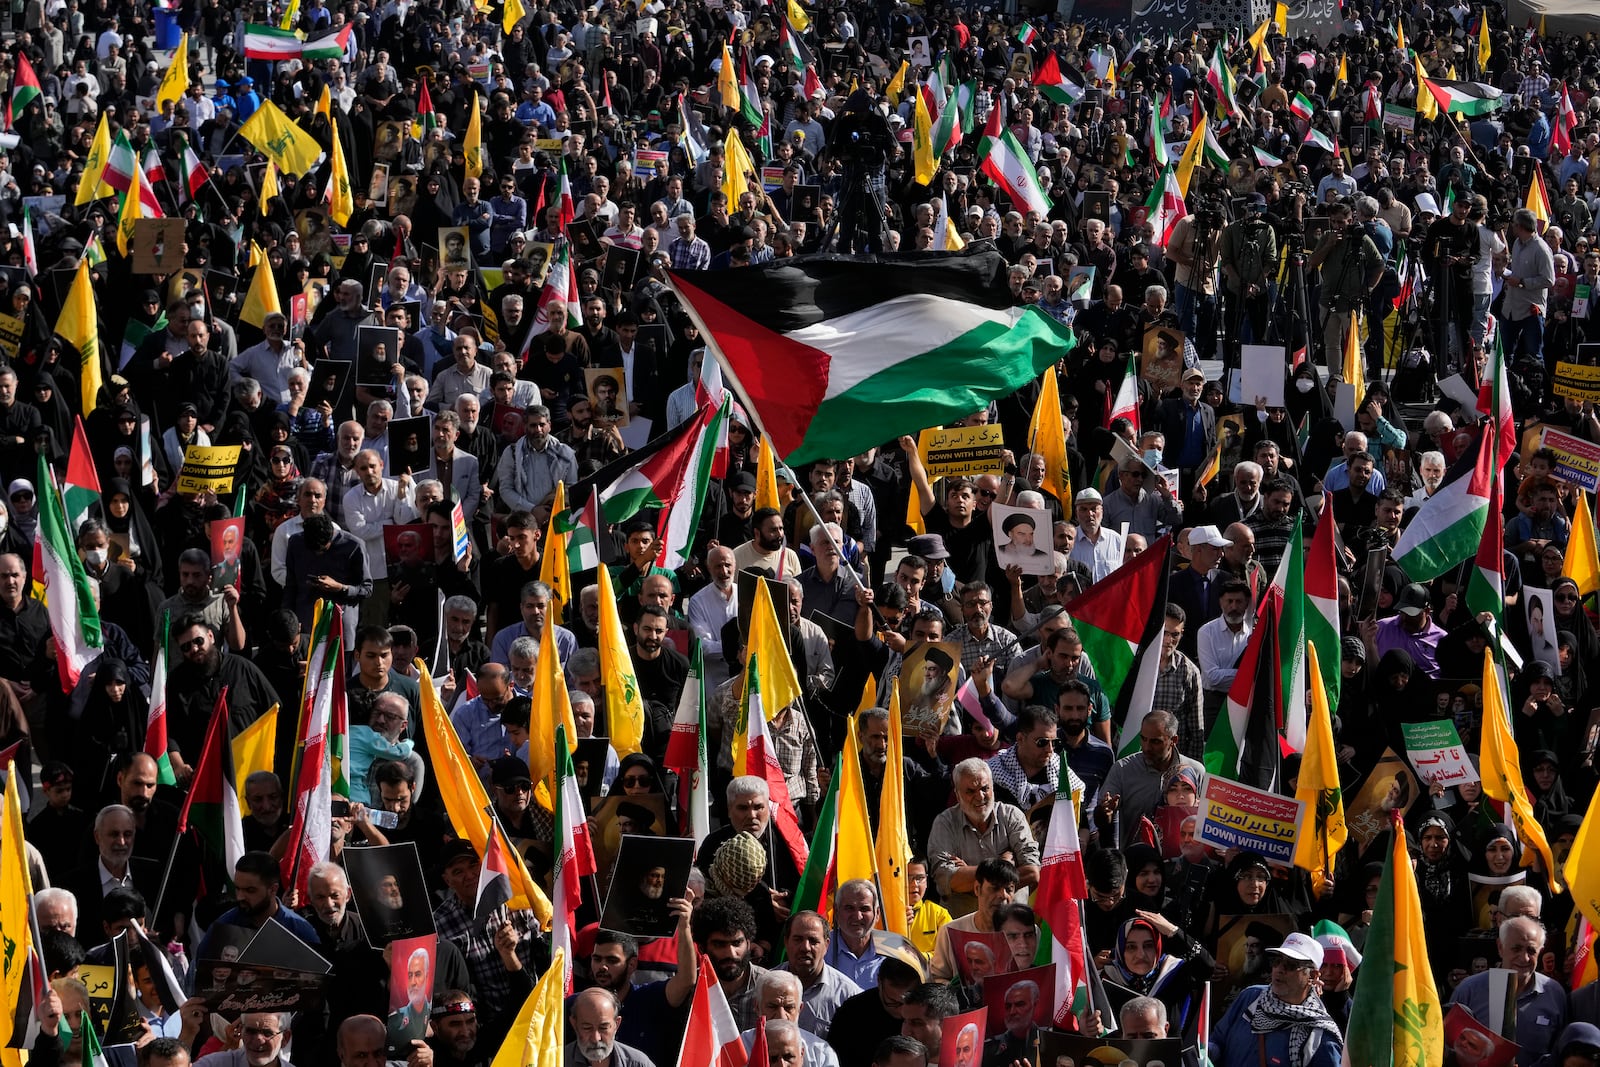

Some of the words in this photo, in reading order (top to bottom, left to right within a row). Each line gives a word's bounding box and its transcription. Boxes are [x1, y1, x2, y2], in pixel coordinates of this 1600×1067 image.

[928, 453, 953, 461] DOWN
[954, 451, 974, 459] WITH
[183, 466, 207, 475] DOWN
[207, 468, 223, 476] WITH
[1562, 468, 1582, 481] WITH
[1581, 474, 1595, 486] USA
[1450, 749, 1460, 761] تا
[1247, 821, 1261, 832] بر
[1204, 823, 1236, 843] DOWN
[1238, 836, 1266, 851] WITH
[1268, 841, 1290, 857] USA
